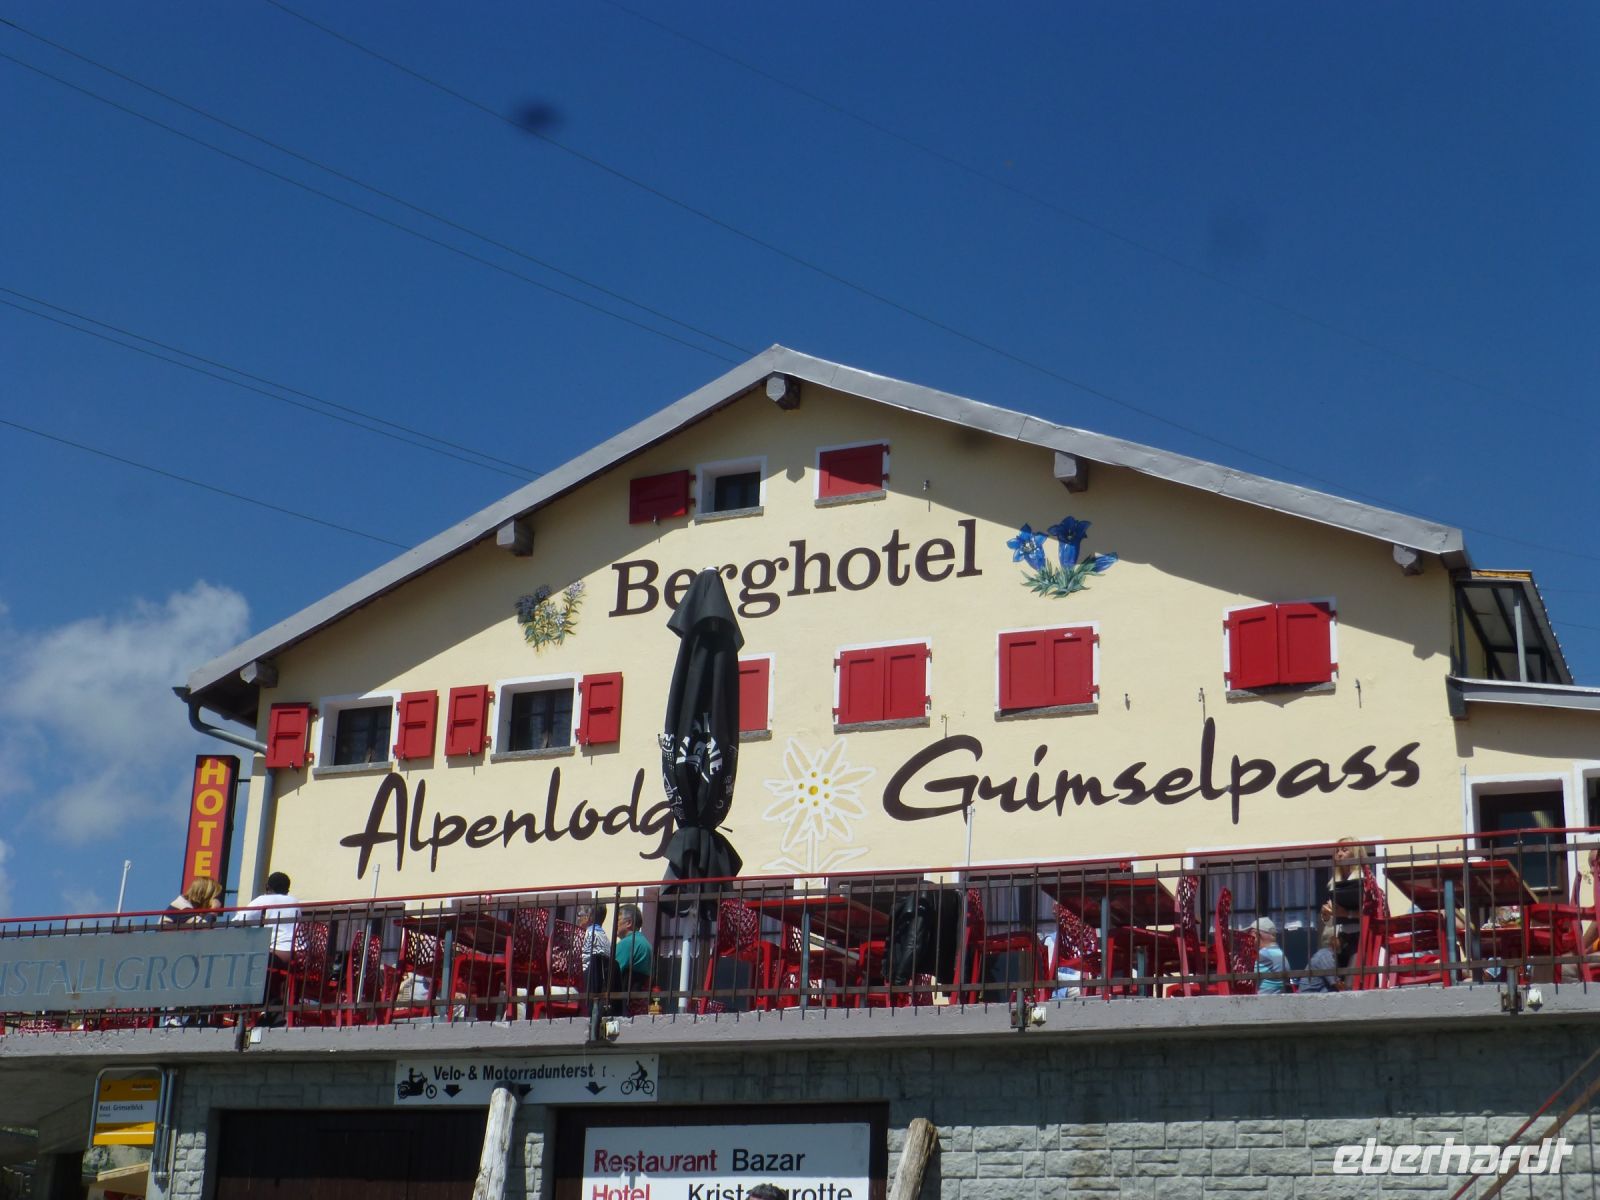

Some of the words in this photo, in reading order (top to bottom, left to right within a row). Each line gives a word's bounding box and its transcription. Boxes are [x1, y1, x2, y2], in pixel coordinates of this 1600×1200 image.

[882, 716, 1421, 825] Grimselpass
[194, 759, 226, 877] HOTE
[340, 766, 677, 880] Alpenlodg
[433, 1065, 465, 1081] Velo-
[468, 1065, 478, 1081] &
[592, 1184, 651, 1200] Hotel
[688, 1183, 853, 1200] Kristrotte
[594, 1149, 717, 1173] Restaurant
[732, 1149, 806, 1171] Bazar
